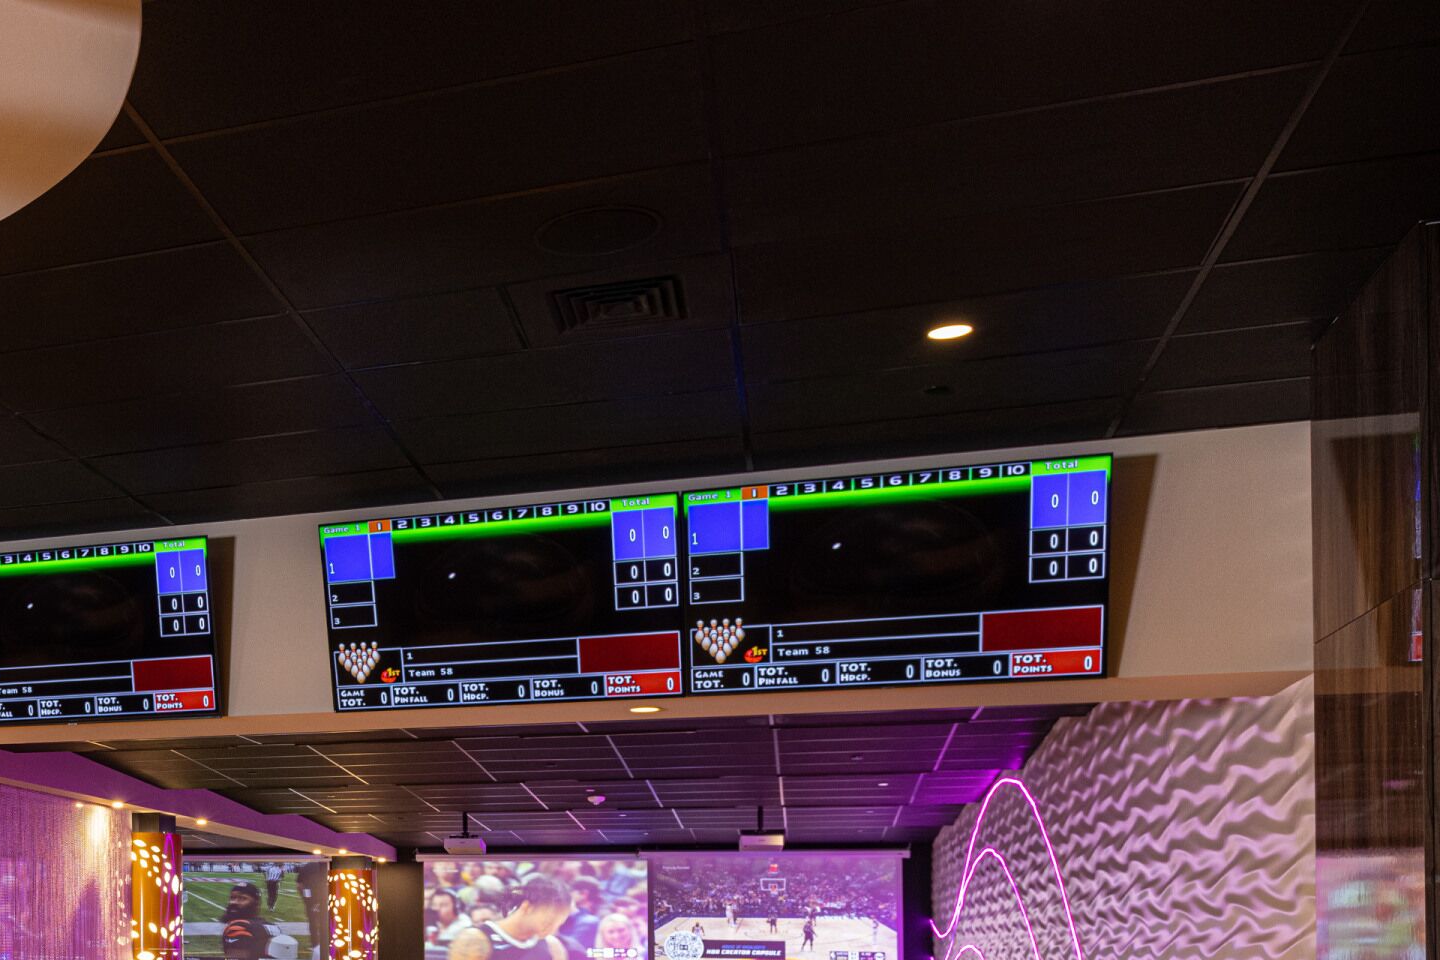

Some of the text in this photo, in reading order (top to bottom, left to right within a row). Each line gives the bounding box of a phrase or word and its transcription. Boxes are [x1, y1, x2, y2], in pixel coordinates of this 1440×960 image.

[1045, 460, 1078, 470] Total
[752, 465, 1025, 498] 1 2 3 4 5 6 7 8 9 10
[622, 498, 650, 507] Total
[688, 493, 718, 501] Game
[1051, 491, 1099, 508] 0 0
[377, 502, 606, 530] 1 2 3 4 5 6 7 8 9 10
[324, 526, 348, 534] Game
[630, 526, 669, 542] 0 0
[1050, 531, 1098, 549] 0 0
[170, 565, 201, 578] 0 0
[631, 563, 671, 579] 0 0
[1049, 558, 1097, 576] 0 0
[632, 587, 672, 603] 0 0
[172, 596, 203, 610] 0 0
[173, 618, 205, 631] 0 0
[777, 646, 830, 656] Team 58
[926, 659, 957, 668] TOT.
[1014, 654, 1047, 663] TOT.
[1084, 656, 1092, 670] 0
[759, 667, 788, 676] TOT.
[841, 663, 871, 672] TOT.
[906, 664, 914, 678] 0
[993, 660, 1002, 674] 0
[1014, 665, 1052, 673] POINTS
[409, 669, 435, 677] Team
[821, 668, 830, 682] 0
[926, 669, 960, 678] BONUS
[535, 680, 561, 688] TOT.
[608, 676, 635, 684] TOT.
[667, 677, 674, 690] 0
[695, 680, 724, 688] TOT.
[742, 672, 750, 686] 0
[394, 687, 419, 695] TOT.
[463, 683, 488, 691] TOT.
[518, 685, 525, 698] 0
[591, 681, 598, 694] 0
[608, 685, 640, 693] POINTS
[381, 692, 387, 704] 0
[448, 688, 454, 701] 0
[535, 689, 564, 697] BONUS
[143, 699, 149, 710] 0
[203, 695, 208, 707] 0
[28, 705, 33, 716] 0
[85, 702, 91, 713] 0
